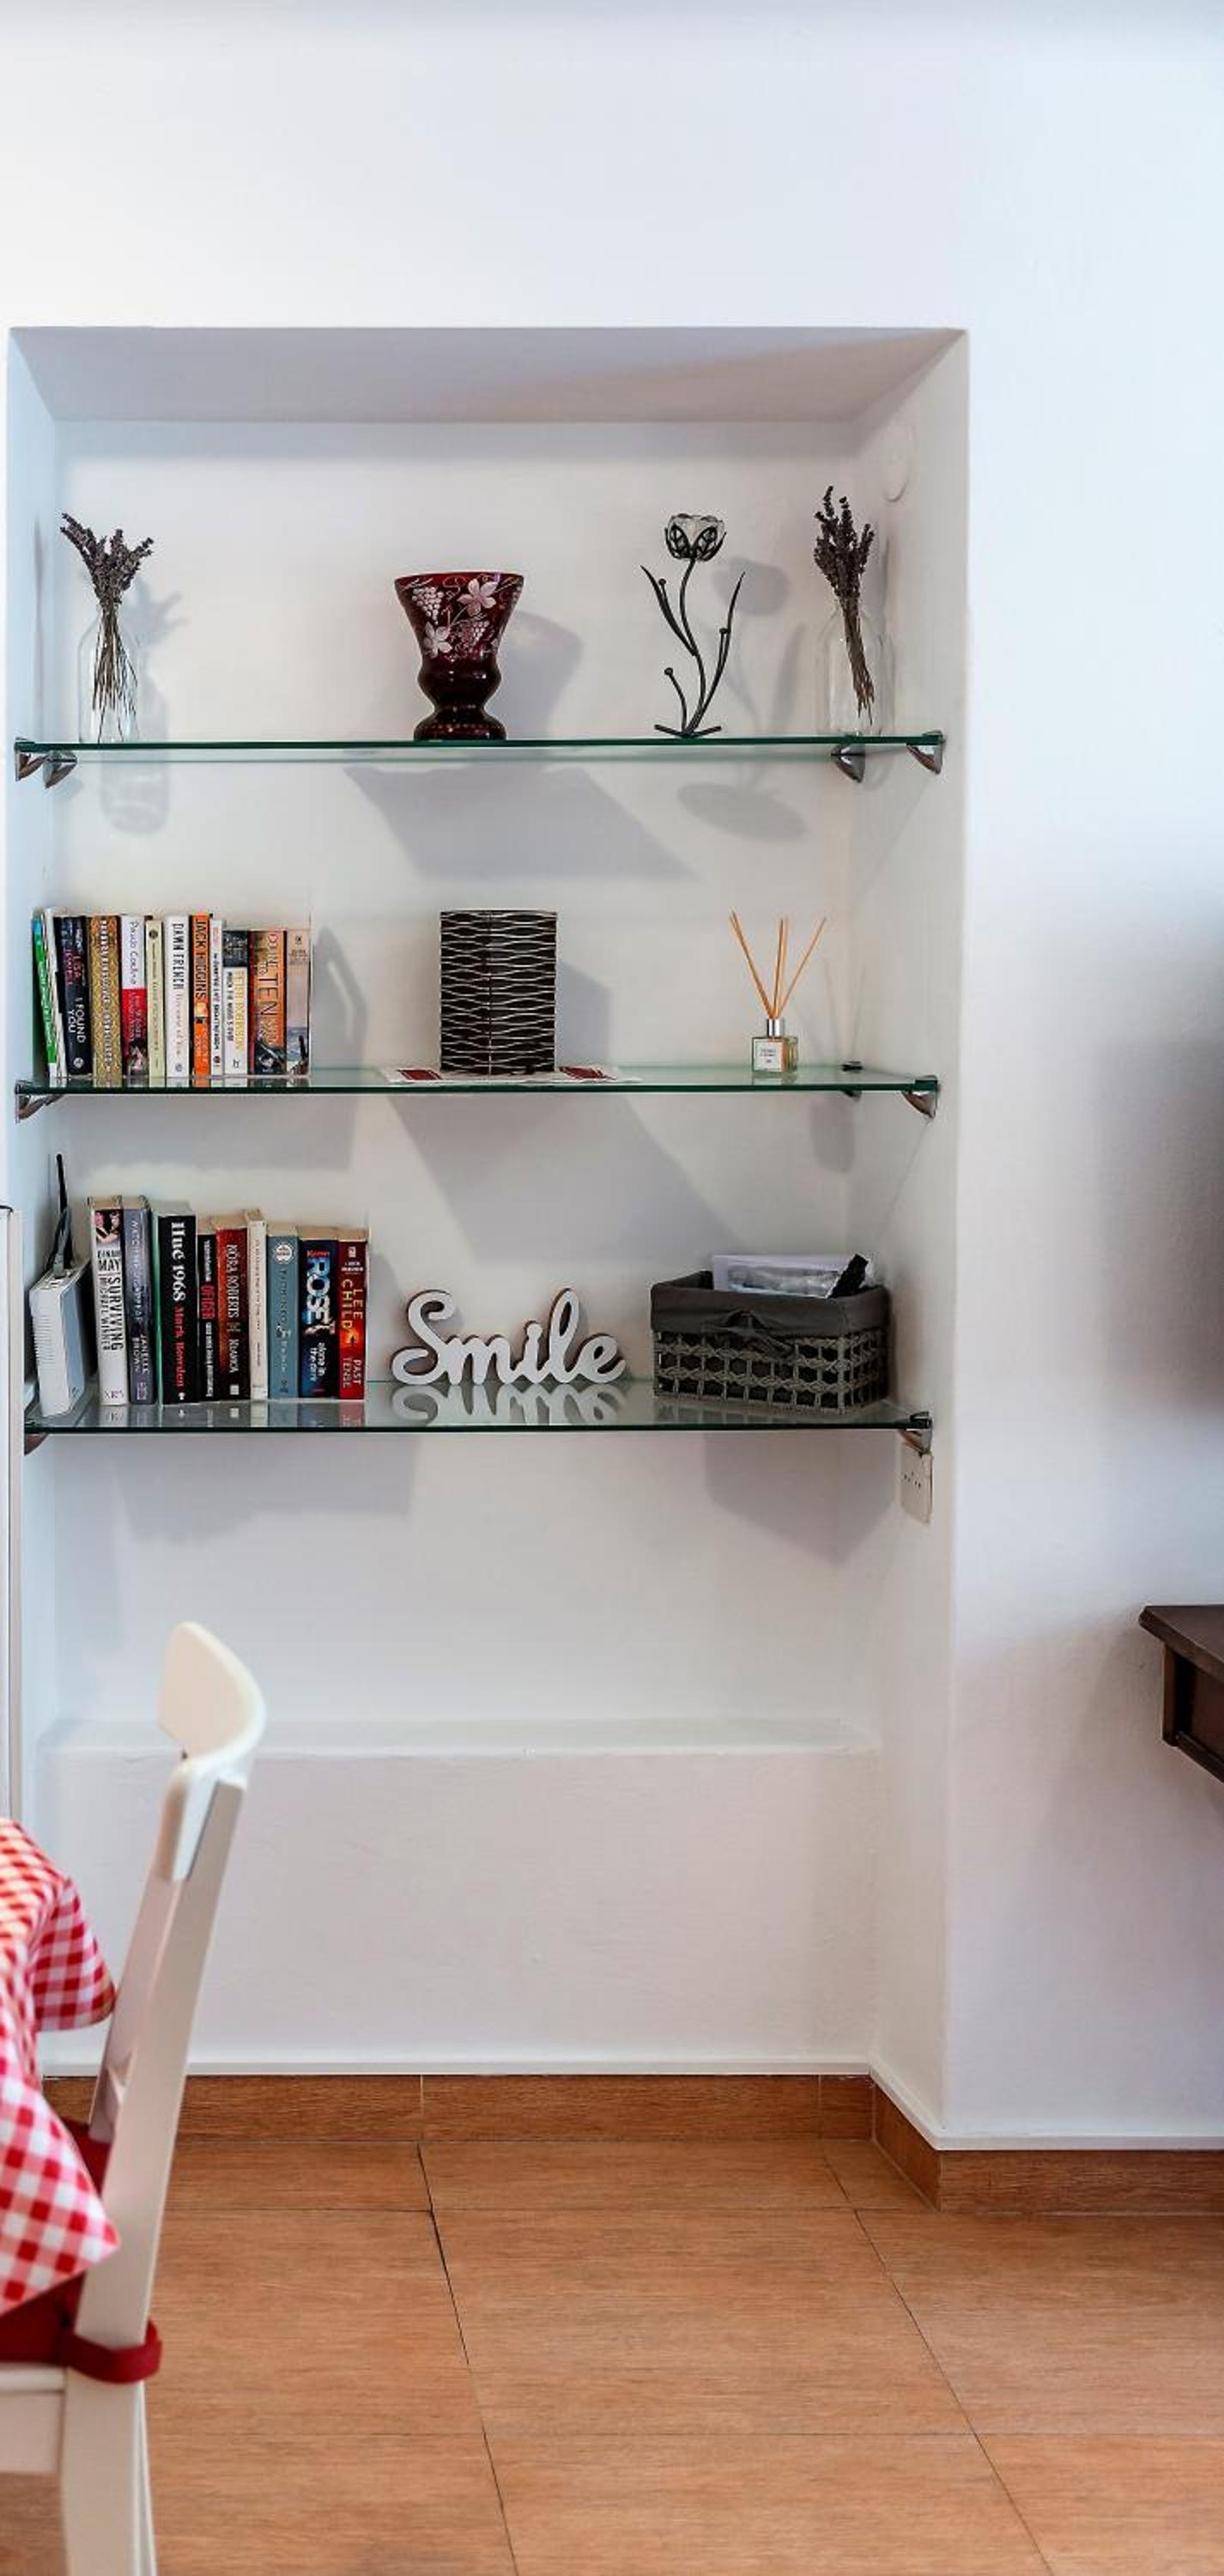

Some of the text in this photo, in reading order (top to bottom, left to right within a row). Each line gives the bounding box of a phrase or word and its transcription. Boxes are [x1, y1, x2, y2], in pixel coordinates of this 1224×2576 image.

[173, 923, 185, 951] DAWN
[173, 953, 185, 990] FRENCH
[195, 917, 209, 999] JACK HIGGINS
[258, 973, 279, 1017] TEN
[68, 1009, 76, 1034] YOU
[75, 1004, 87, 1043] FOUND
[98, 1259, 122, 1271] MAY
[171, 1265, 186, 1303] 1968
[226, 1275, 240, 1319] ROBERTS
[305, 1257, 331, 1325] ROSE
[106, 1277, 124, 1352] SURVIVING
[173, 1305, 185, 1338] Mark
[342, 1279, 354, 1329] CHILD
[353, 1289, 364, 1320] LEE
[141, 1334, 150, 1374] JANELLE
[391, 1287, 627, 1384] Smile
[309, 1347, 318, 1362] the
[317, 1342, 327, 1376] alone in
[353, 1359, 362, 1385] PAST
[342, 1358, 352, 1389] TENSE
